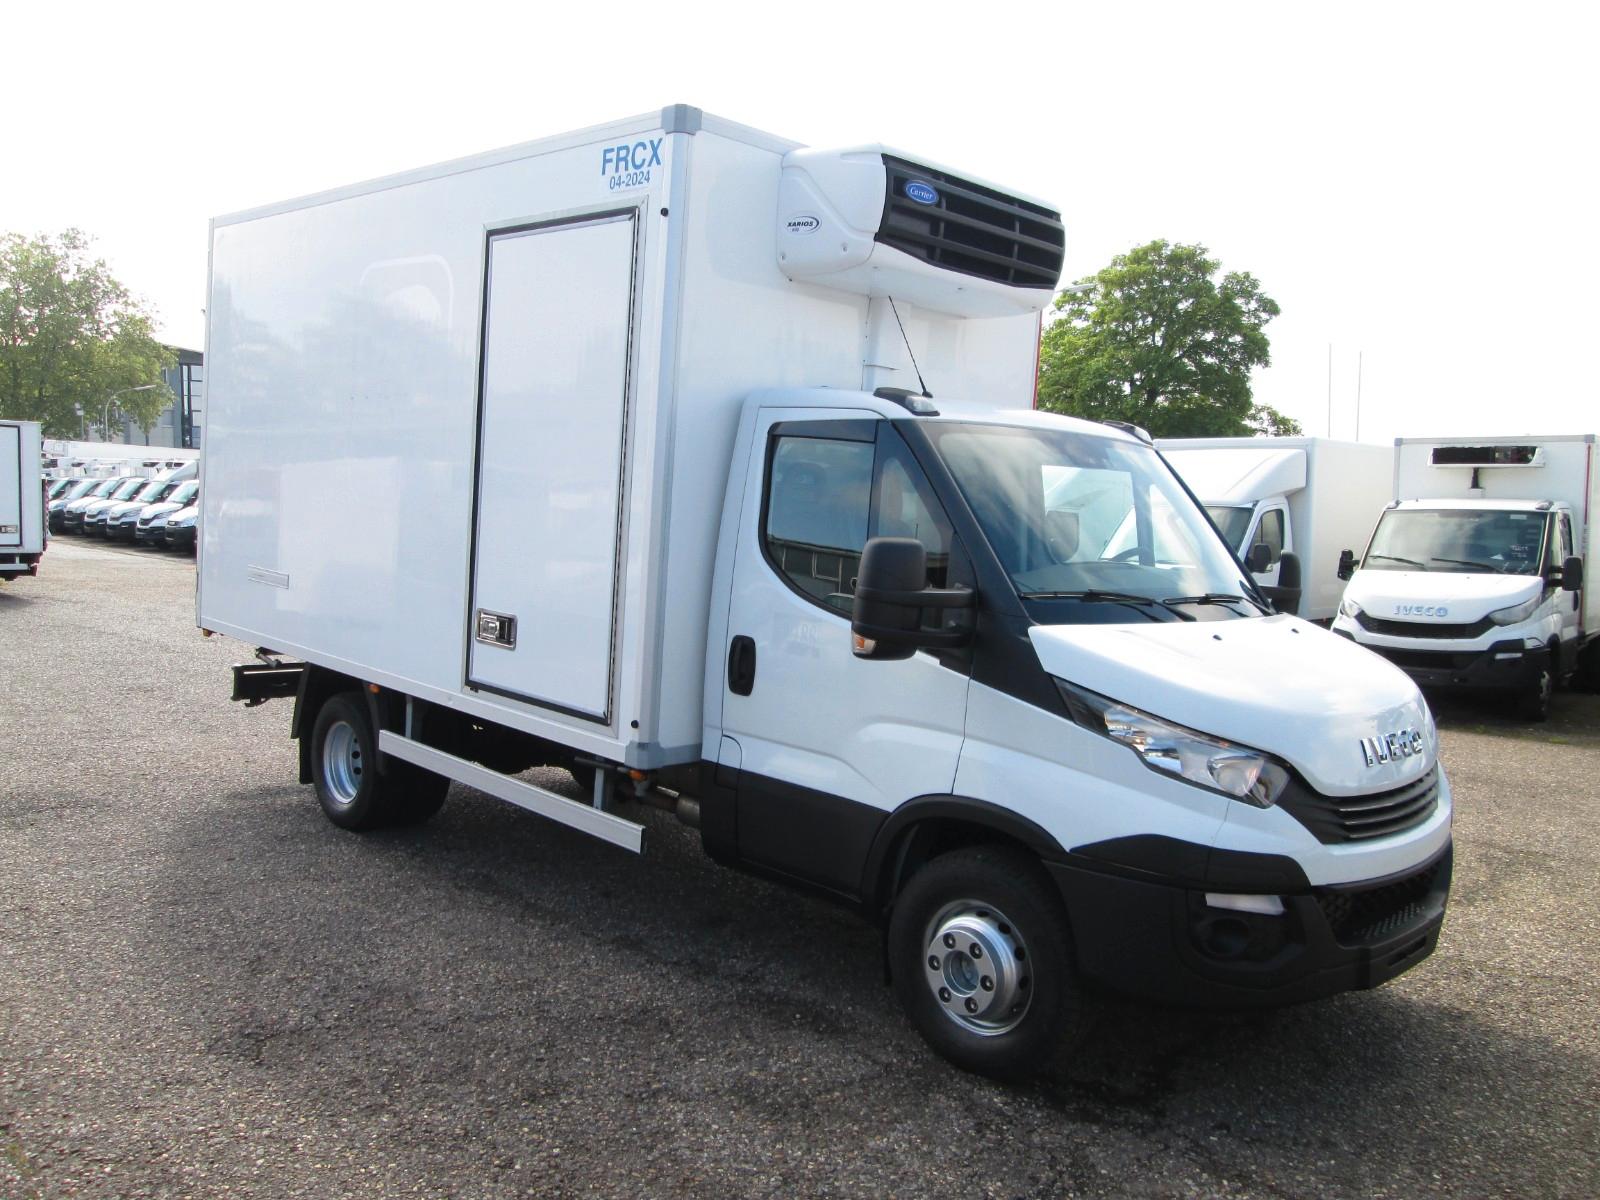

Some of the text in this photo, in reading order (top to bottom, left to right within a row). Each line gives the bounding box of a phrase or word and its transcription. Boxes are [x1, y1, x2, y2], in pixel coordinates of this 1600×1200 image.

[602, 138, 663, 176] FRCX
[610, 170, 650, 190] 04-2024
[910, 186, 933, 200] Carrier
[1393, 605, 1448, 617] IVECO
[1360, 728, 1422, 767] IVECO
